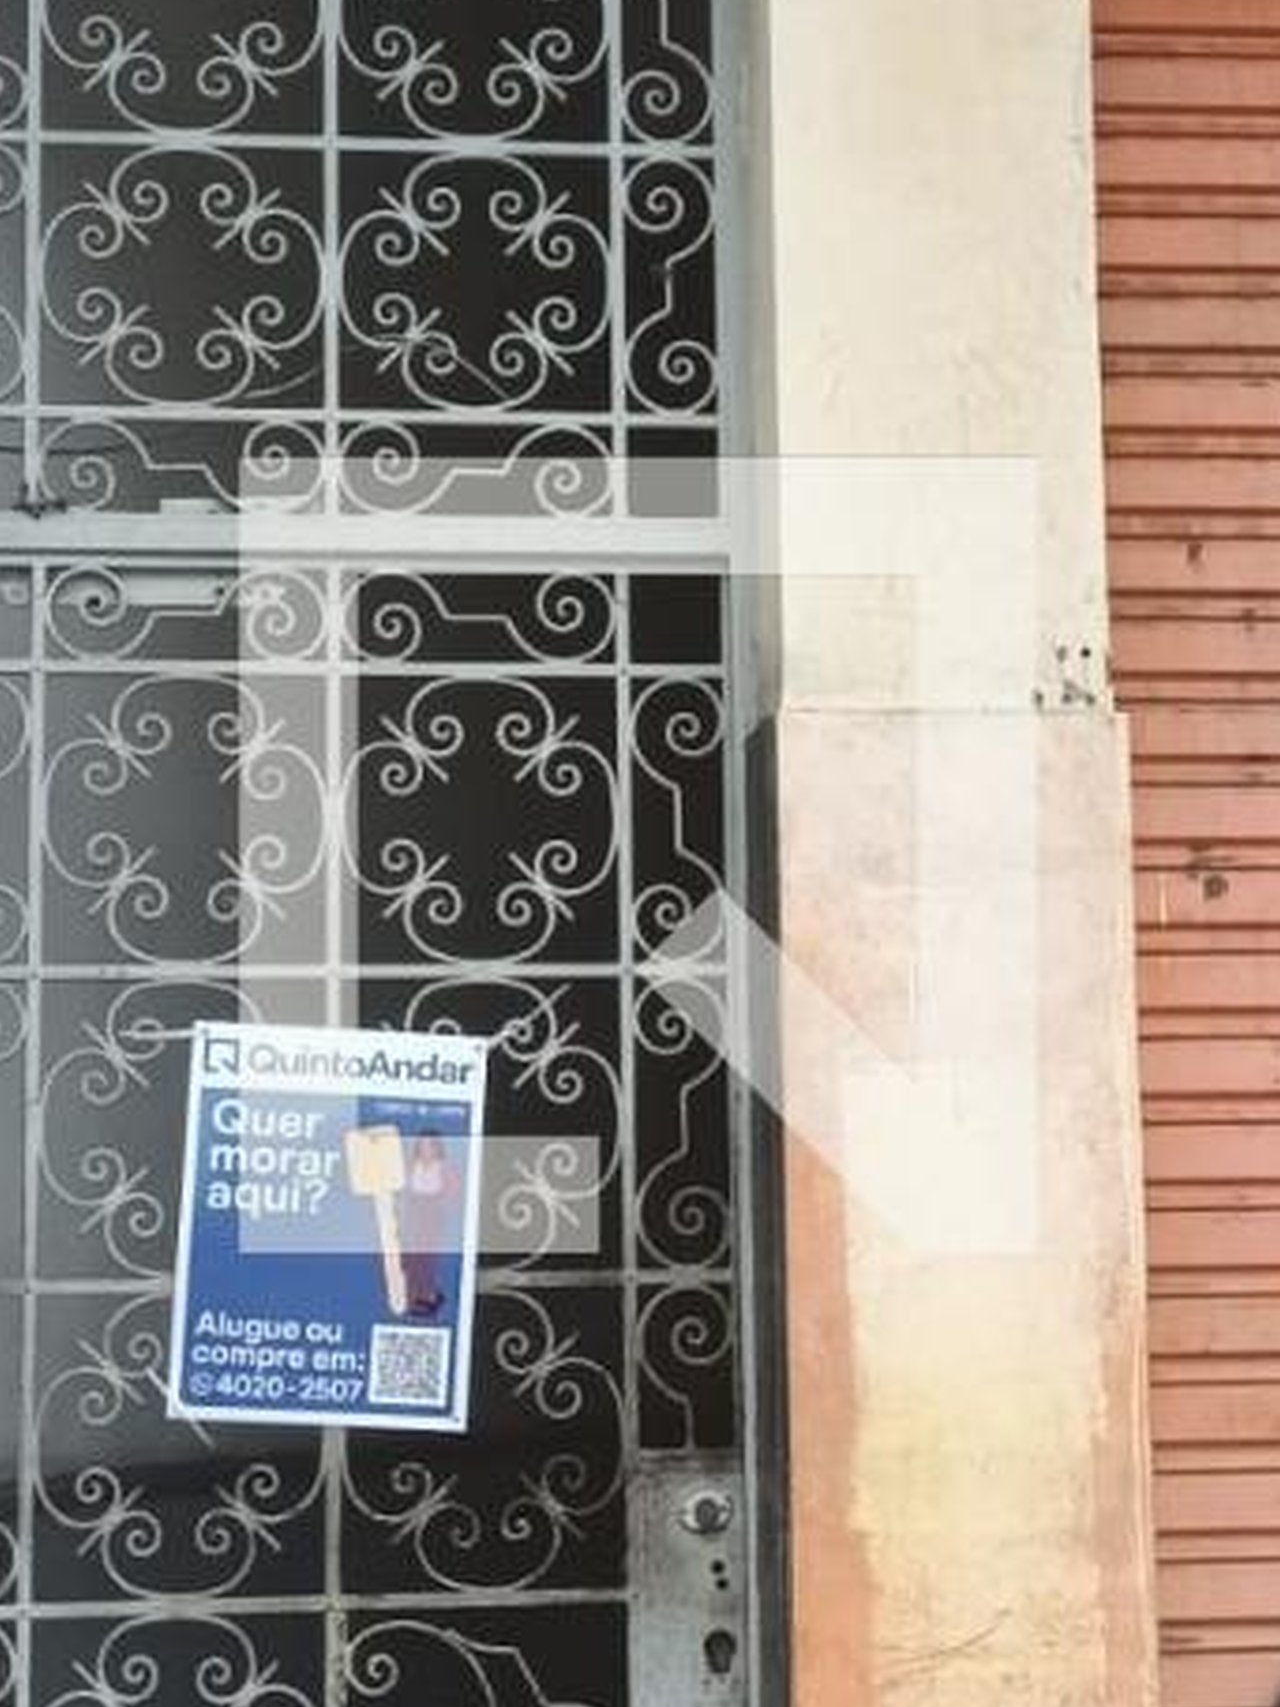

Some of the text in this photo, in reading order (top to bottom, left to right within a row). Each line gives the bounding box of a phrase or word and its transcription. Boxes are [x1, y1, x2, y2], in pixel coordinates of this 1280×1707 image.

[248, 1044, 472, 1084] QuintoAndar
[213, 1098, 324, 1139] Quer
[209, 1144, 340, 1176] morar
[206, 1179, 329, 1218] aqui?
[194, 1309, 343, 1344] Alugue ou
[191, 1344, 367, 1374] compre em:
[216, 1372, 364, 1403] 4020-2507
